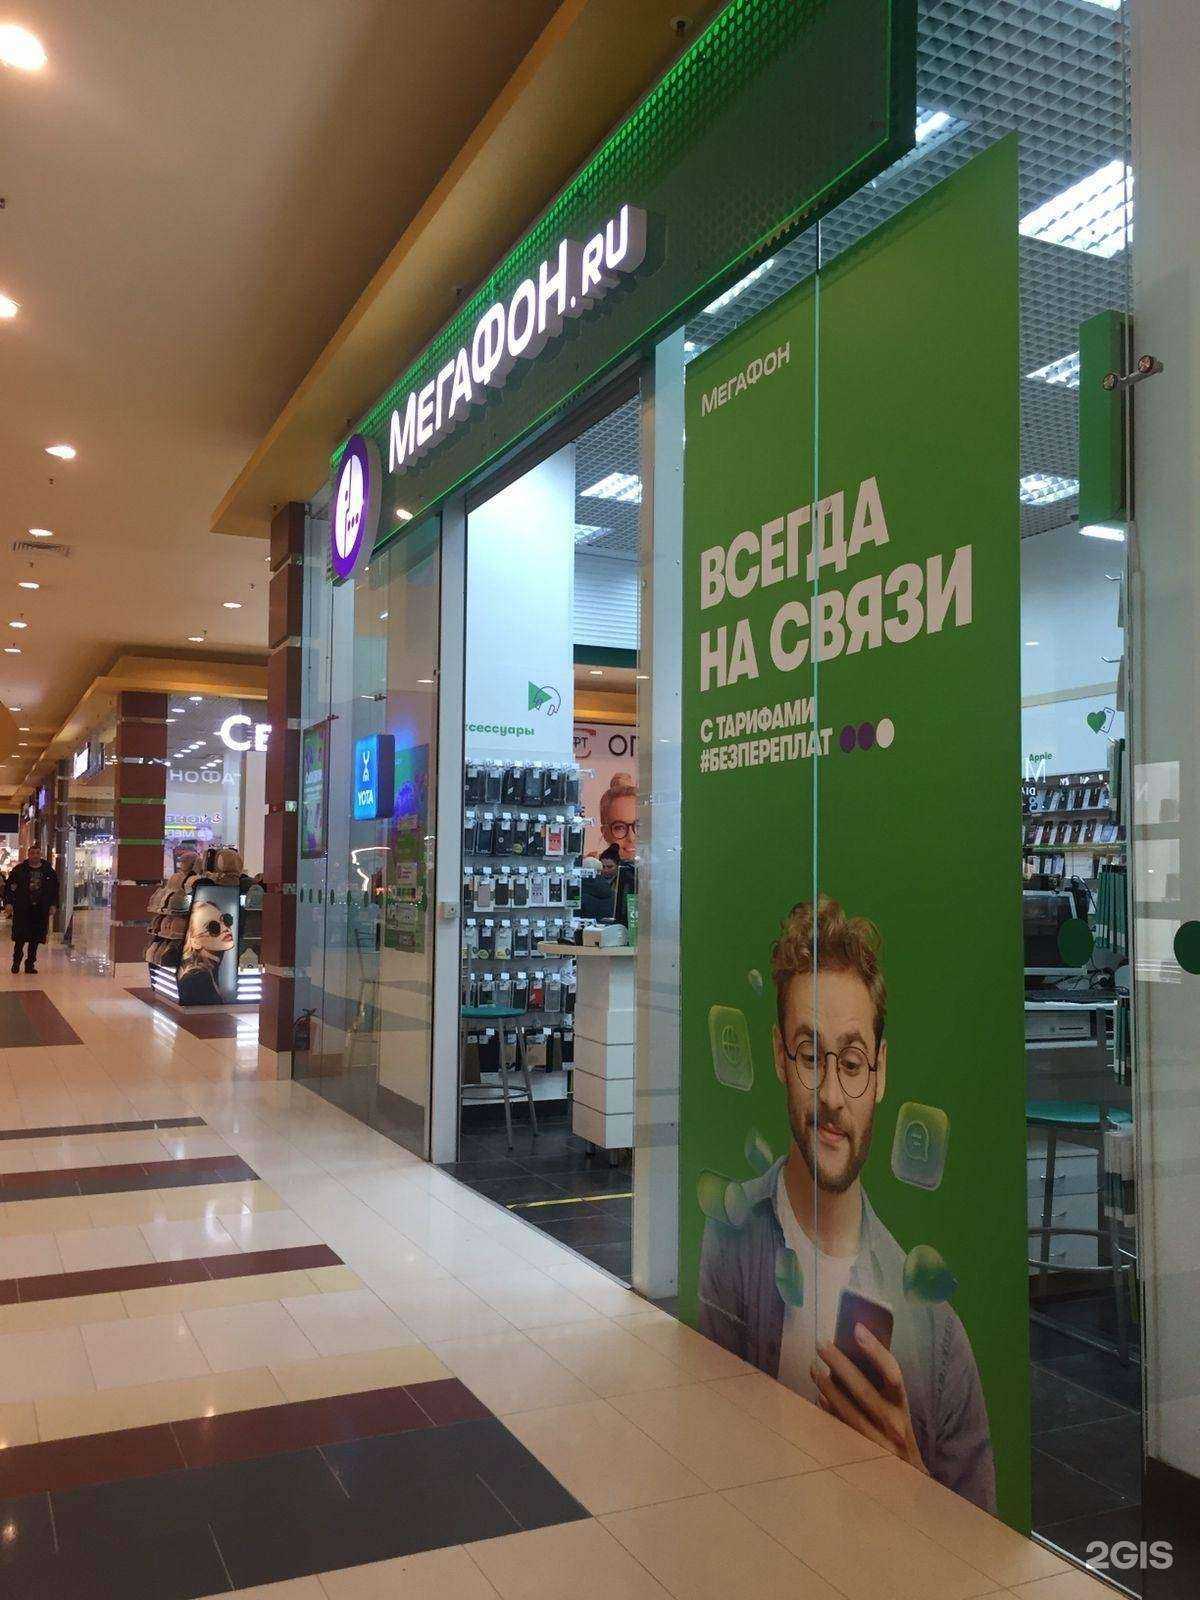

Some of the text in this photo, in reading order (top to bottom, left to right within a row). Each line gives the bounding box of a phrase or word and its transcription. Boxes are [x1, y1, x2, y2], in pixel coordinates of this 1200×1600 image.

[701, 341, 791, 417] МЕГАФОН
[700, 475, 890, 611] ВСЕГДА
[700, 543, 974, 692] НА СВЯЗИ
[700, 696, 816, 744] С ТАРИФАМИ
[700, 728, 834, 773] #БЕЗПЕРЕПЛАТ
[1029, 752, 1053, 763] Apple
[358, 789, 374, 806] YOTA
